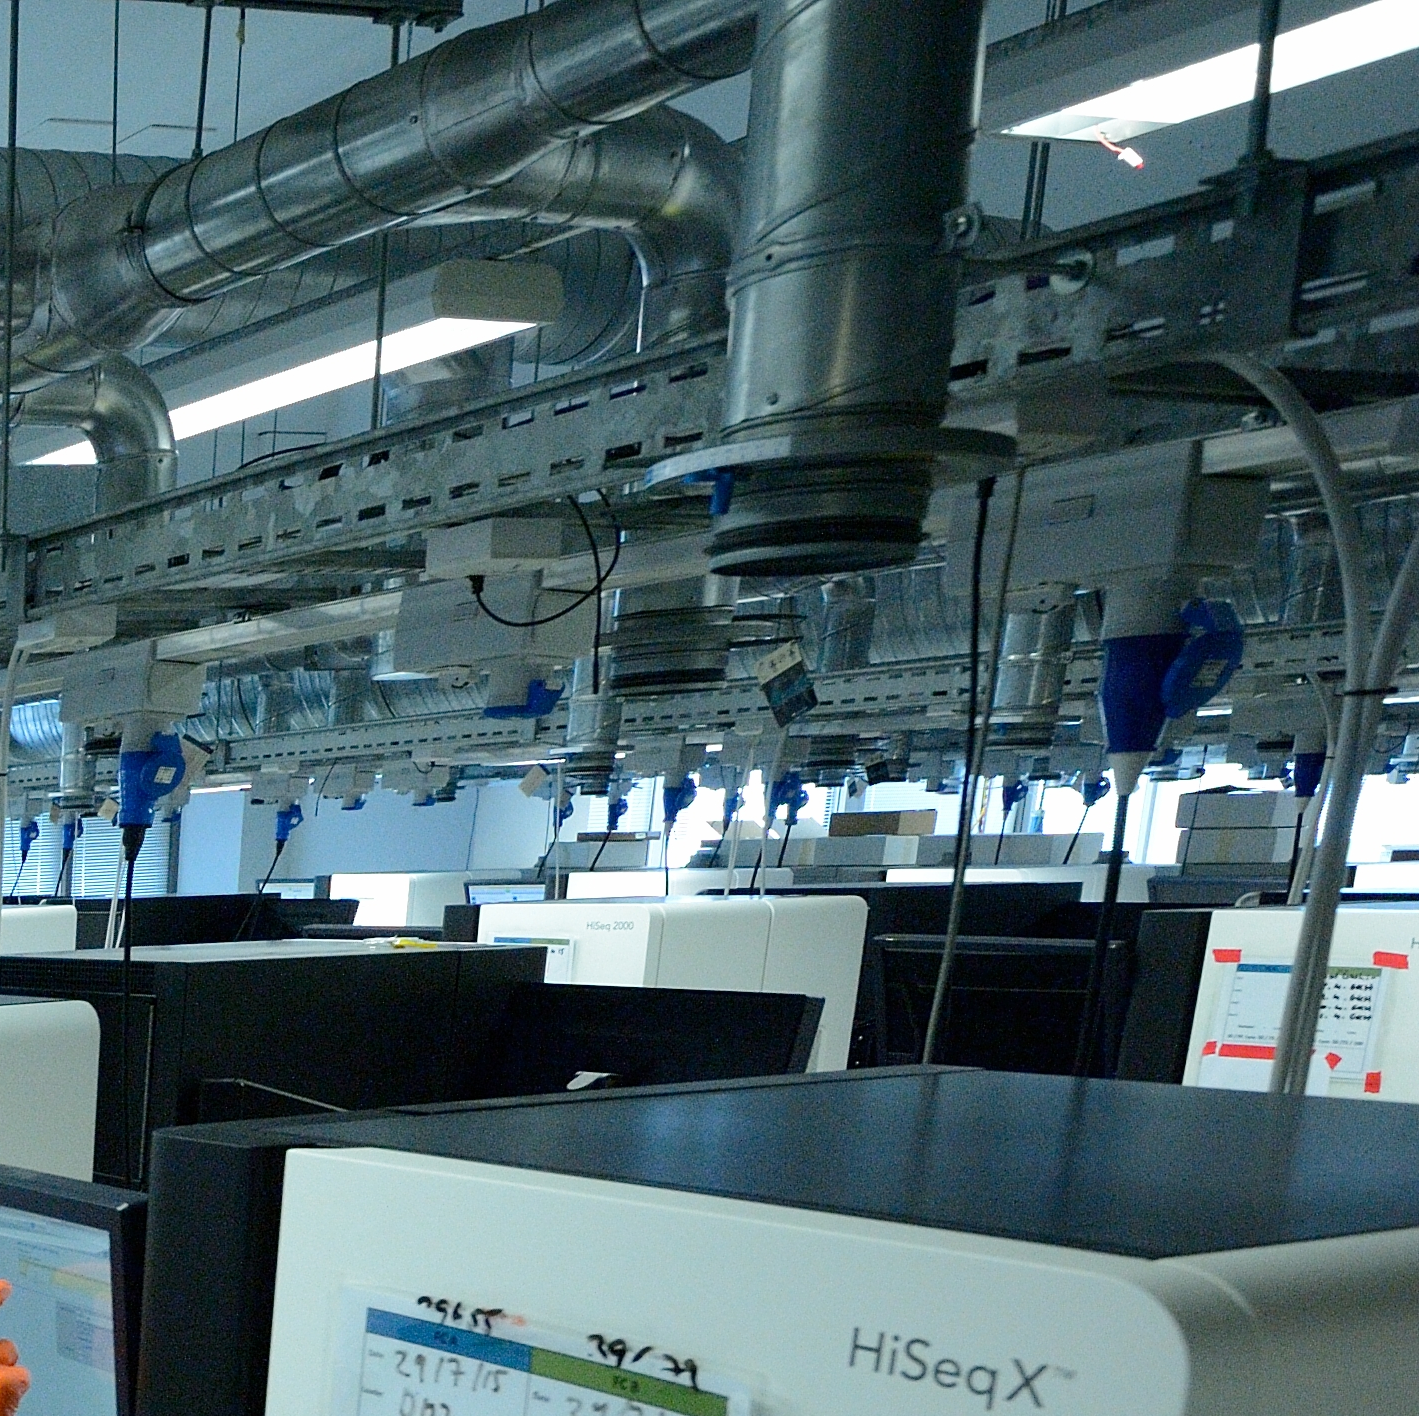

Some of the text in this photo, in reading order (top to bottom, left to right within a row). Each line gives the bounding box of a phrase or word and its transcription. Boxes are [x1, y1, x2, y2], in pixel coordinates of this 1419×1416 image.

[586, 920, 635, 932] HiSeq 2000
[848, 1327, 998, 1411] HiSeq
